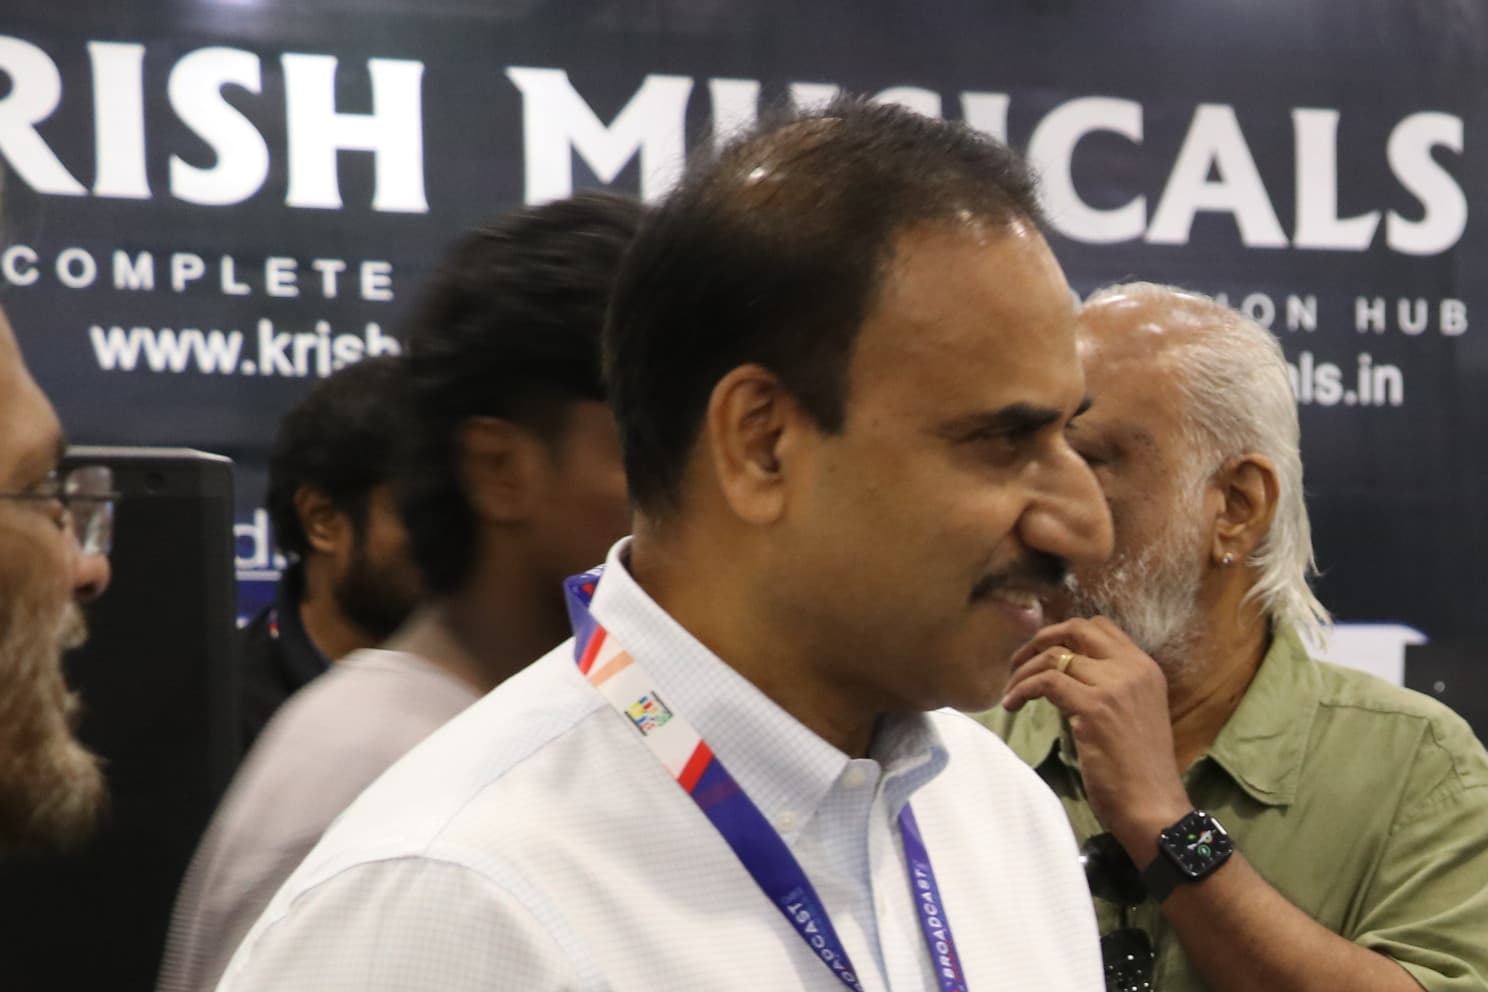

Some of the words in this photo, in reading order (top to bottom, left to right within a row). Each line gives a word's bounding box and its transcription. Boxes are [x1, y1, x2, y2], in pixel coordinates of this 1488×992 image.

[505, 66, 1468, 256] MCALS
[1, 244, 395, 301] COMPLETE
[1355, 296, 1469, 336] HUB
[1287, 350, 1405, 407] ls.in
[913, 868, 956, 980] BROADCAST
